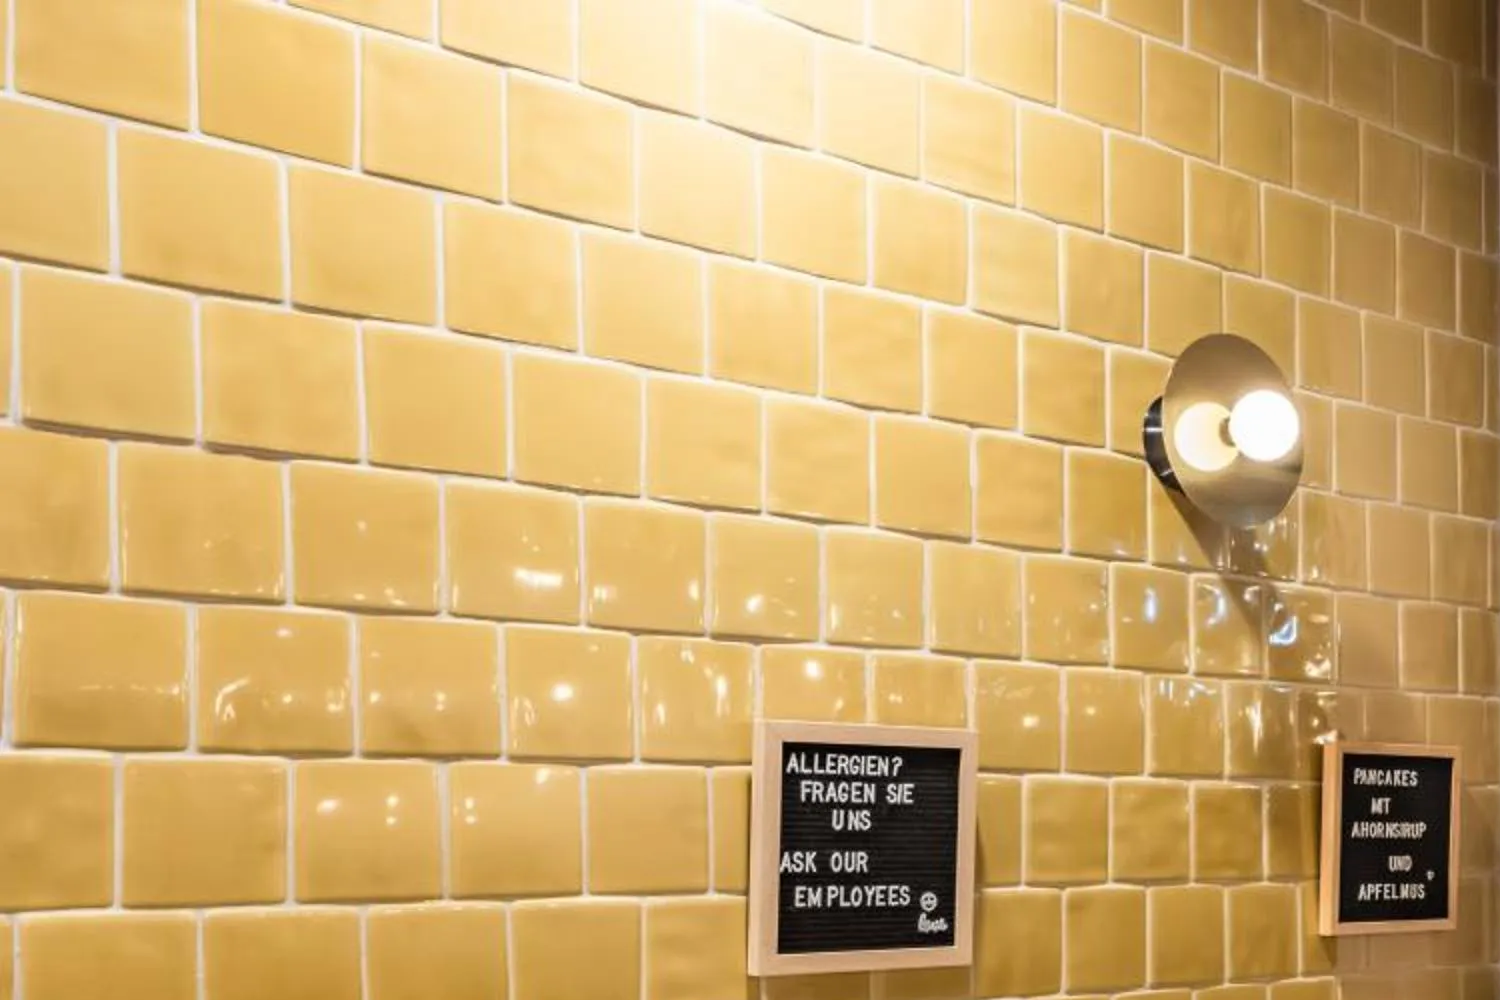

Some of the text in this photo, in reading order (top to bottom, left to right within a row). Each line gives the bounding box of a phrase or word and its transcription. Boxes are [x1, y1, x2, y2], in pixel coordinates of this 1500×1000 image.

[786, 752, 903, 777] ALLERGIEN?
[1353, 767, 1419, 787] PANCAKES
[800, 780, 915, 804] FRAGEN SIE
[831, 809, 872, 831] UNS
[1351, 821, 1427, 839] AHORNSIRUP
[780, 851, 869, 873] ASK OUR
[1388, 855, 1413, 872] UND
[794, 885, 911, 907] EMPLOYEES
[1358, 883, 1425, 901] APFELMUS
